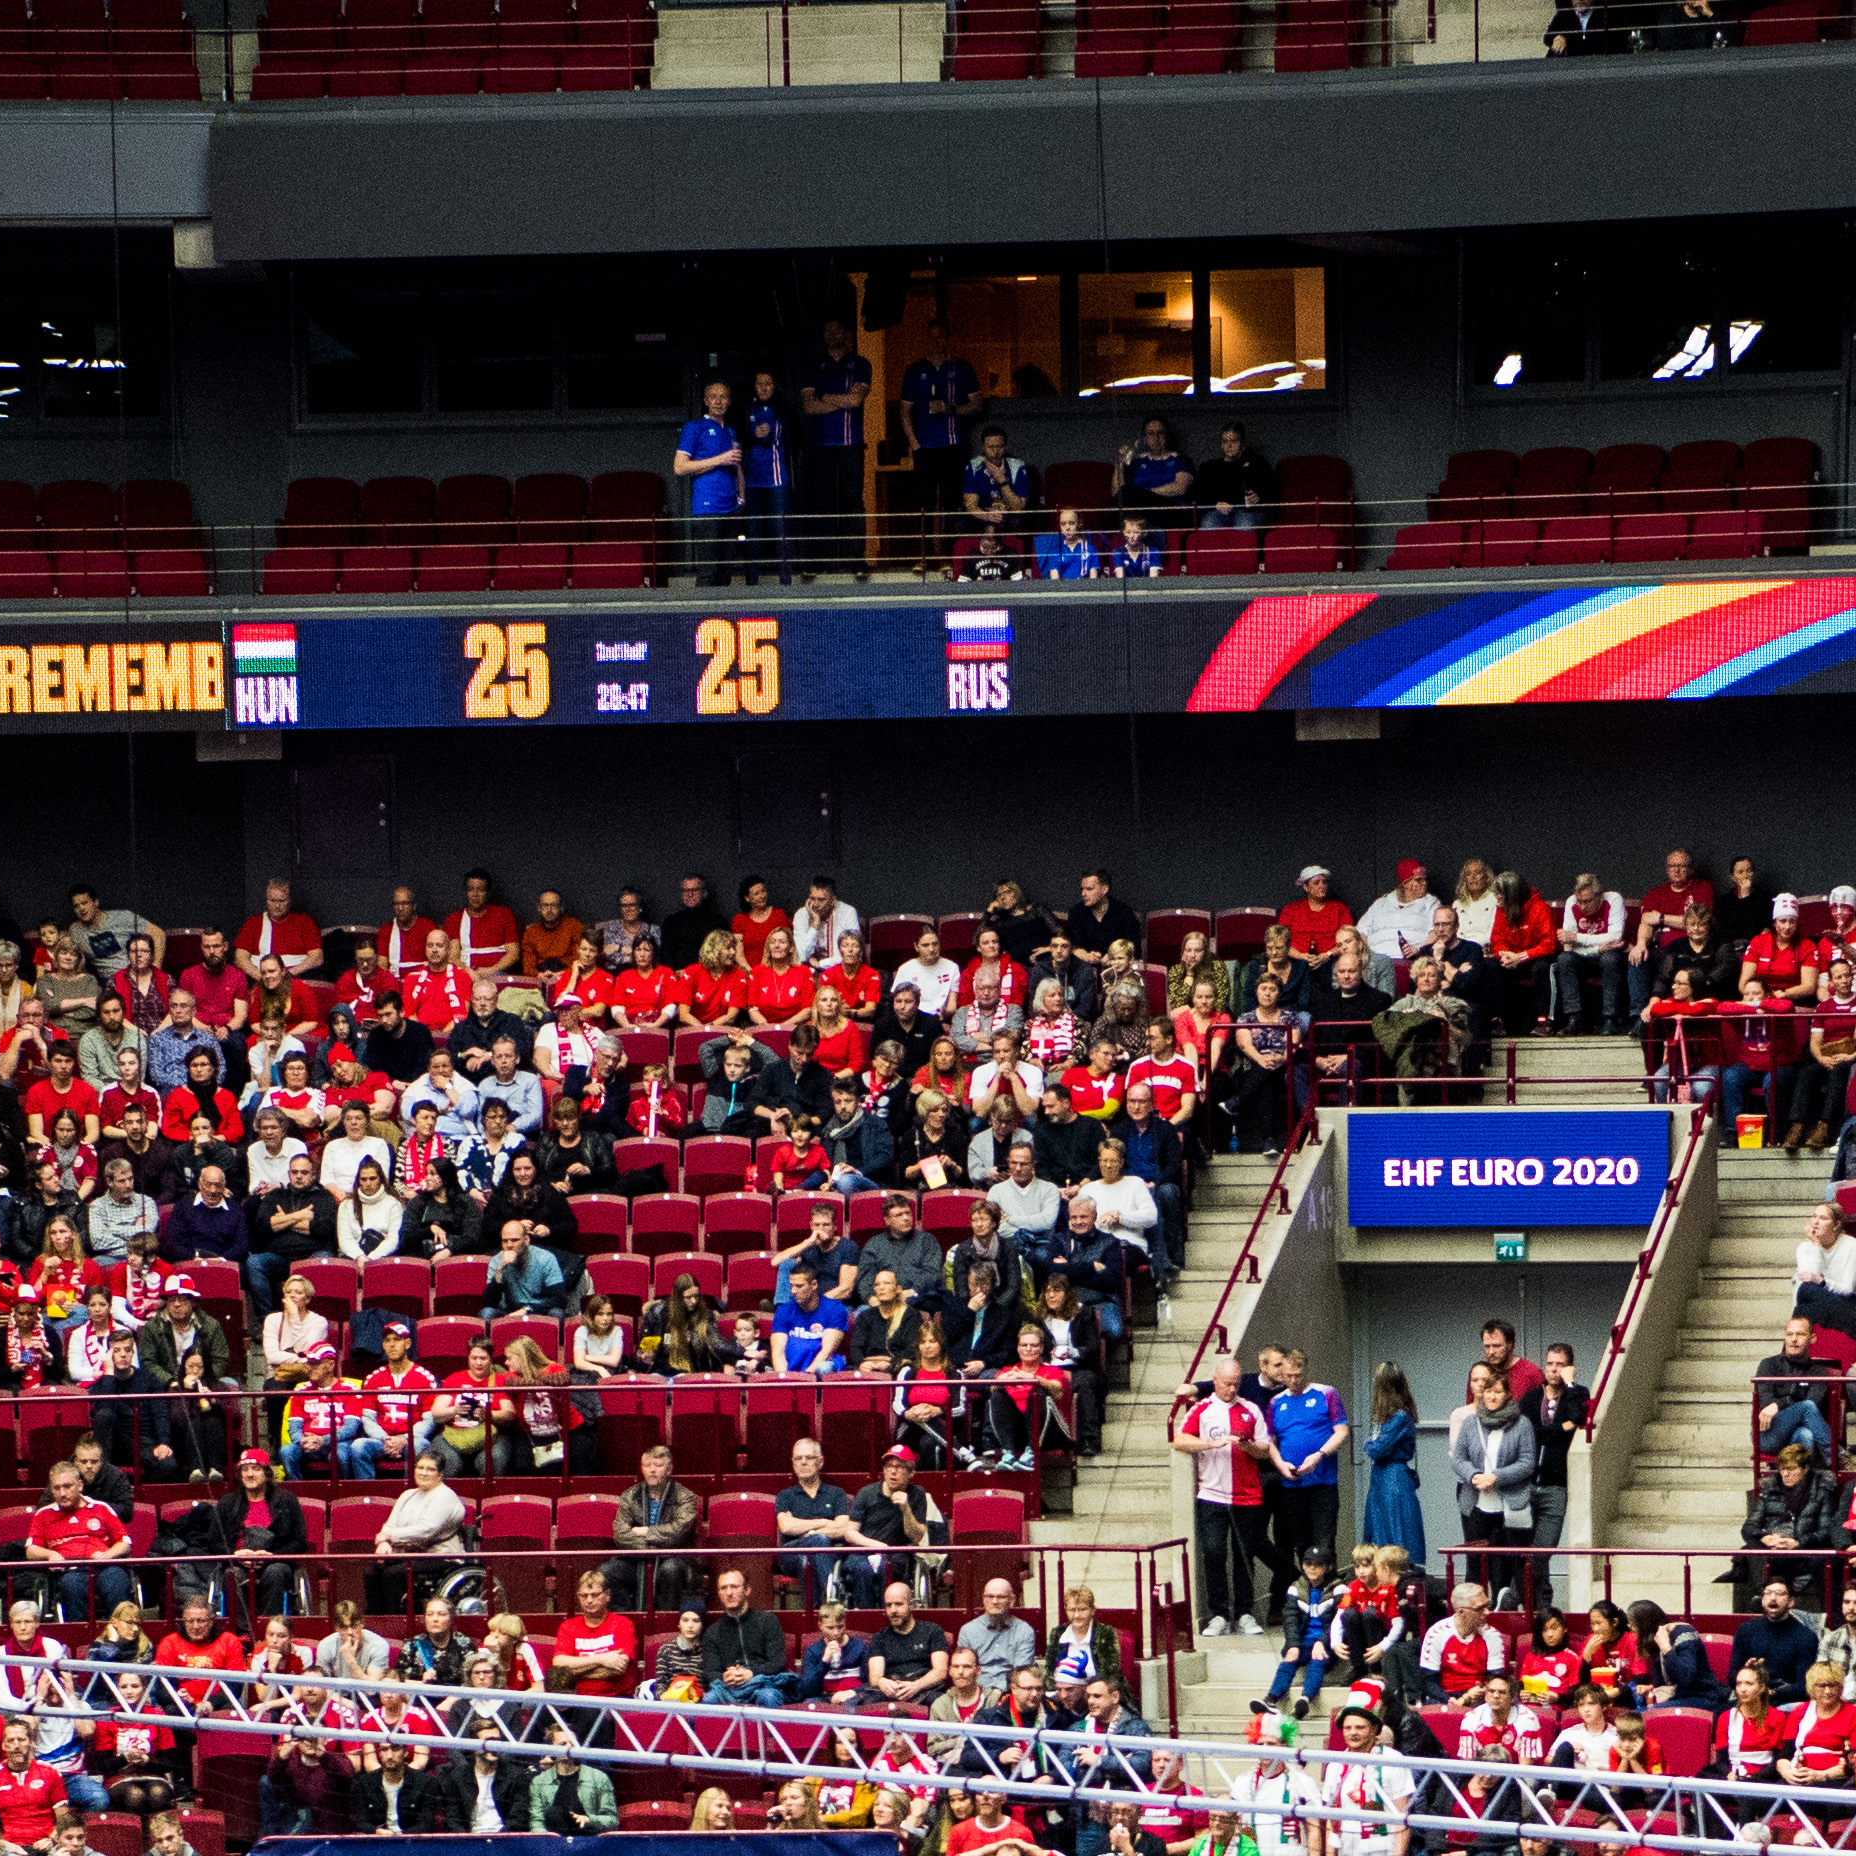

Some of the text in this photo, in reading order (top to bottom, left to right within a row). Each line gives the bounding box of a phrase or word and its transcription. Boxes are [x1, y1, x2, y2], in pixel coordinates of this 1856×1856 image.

[464, 623, 550, 718] 25
[696, 619, 779, 714] 25
[948, 662, 1011, 711] RUS
[235, 676, 299, 725] HUN
[1383, 1157, 1639, 1187] EHF EURO 2020
